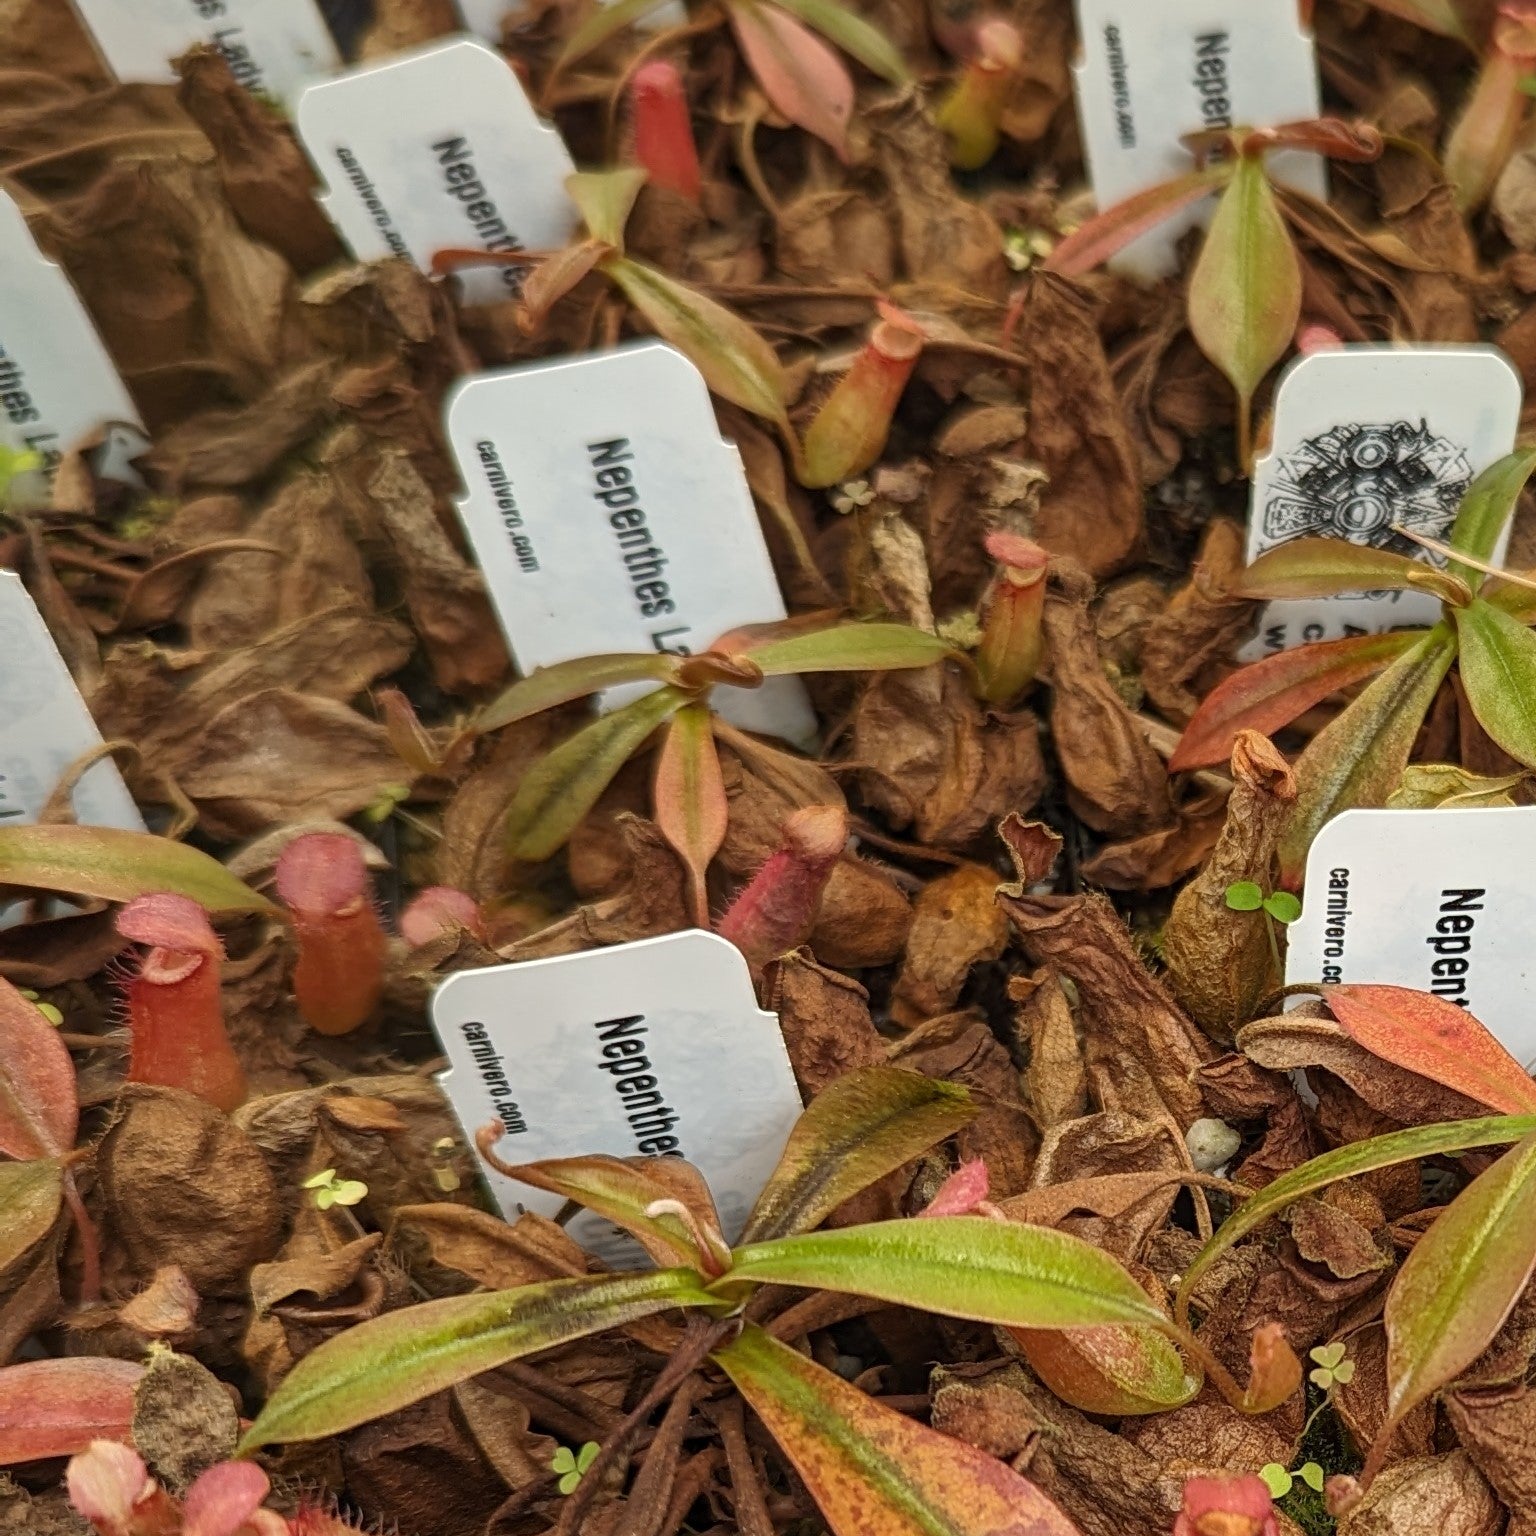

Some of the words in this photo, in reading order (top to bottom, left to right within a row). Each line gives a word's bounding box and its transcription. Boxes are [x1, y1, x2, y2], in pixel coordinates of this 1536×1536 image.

[476, 440, 541, 573] carnivero.com
[587, 437, 676, 619] Nepenthes
[1321, 868, 1350, 985] carnivero.co
[1426, 889, 1486, 1006] Nepen
[460, 1021, 528, 1135] carnivero.com
